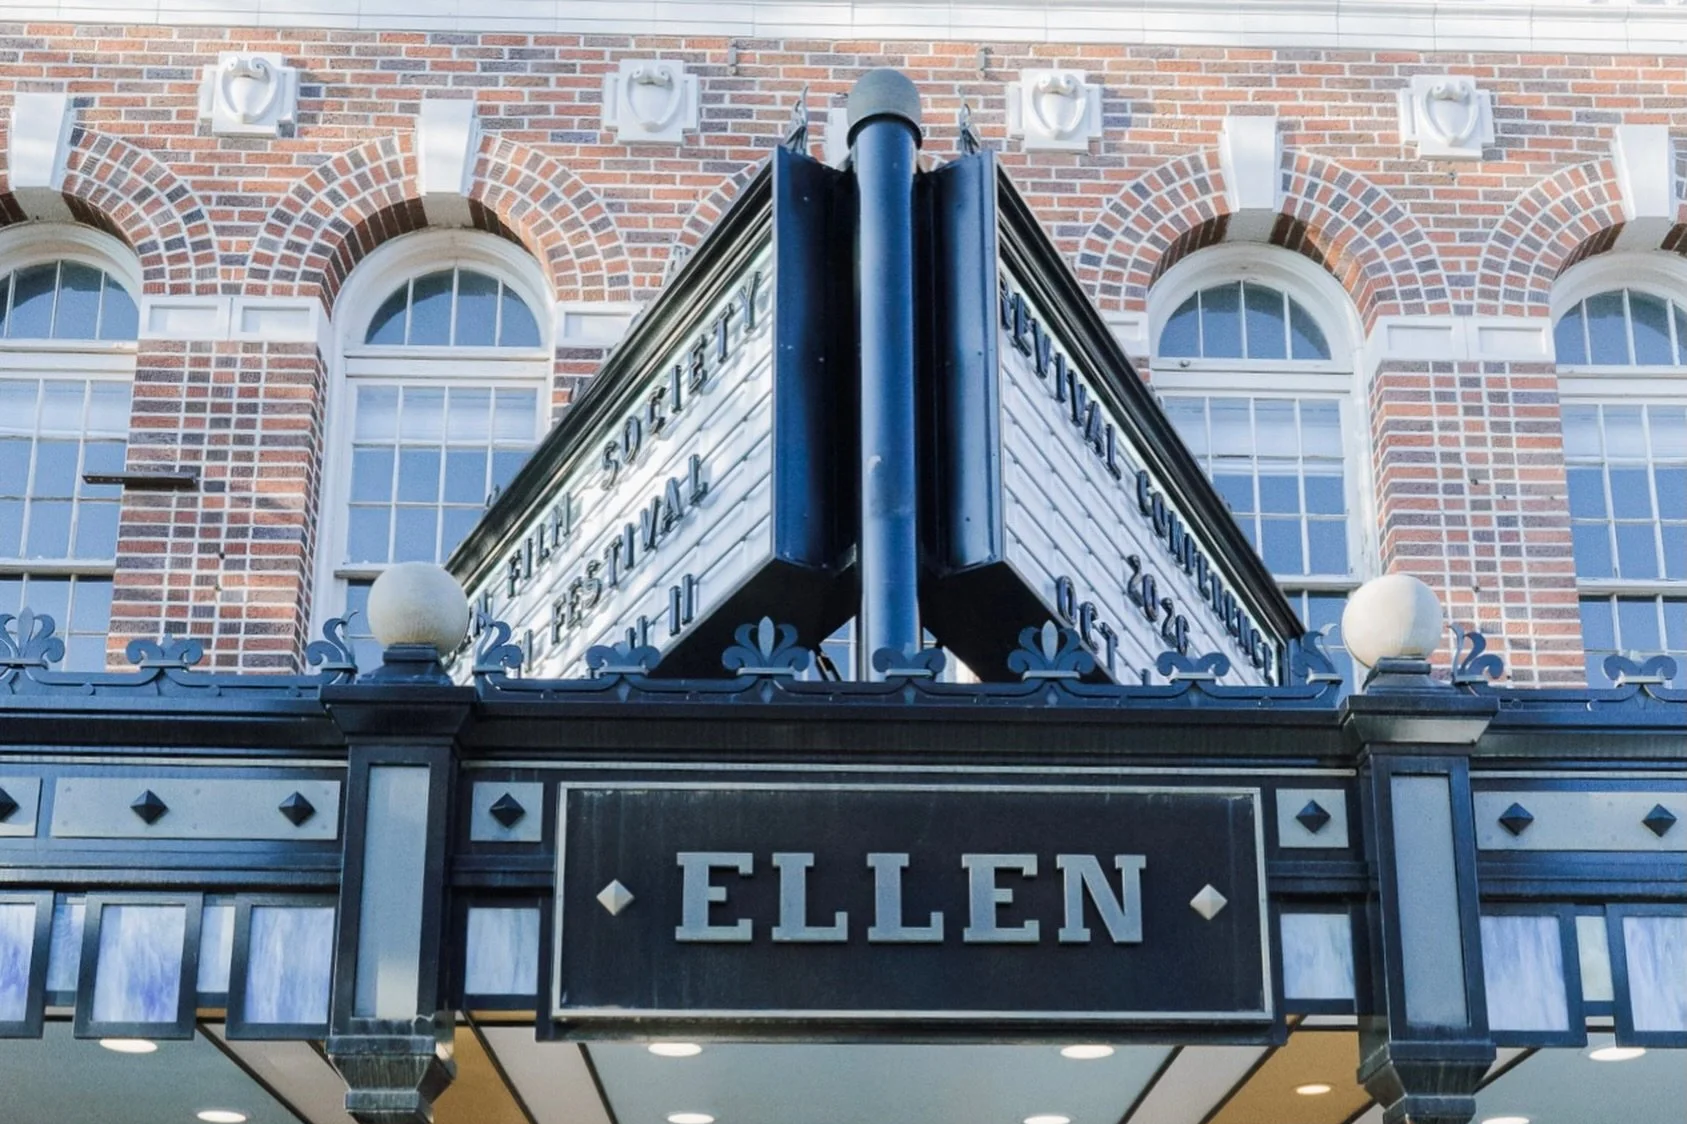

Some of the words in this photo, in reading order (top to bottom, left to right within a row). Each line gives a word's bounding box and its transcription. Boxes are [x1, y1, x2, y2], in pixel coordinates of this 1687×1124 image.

[507, 490, 573, 599] FILM
[600, 270, 762, 491] SOCIETY
[1000, 270, 1122, 481] REVIVAL
[551, 454, 709, 645] FESTIVAL
[1056, 575, 1119, 672] OCT
[675, 851, 1147, 944] ELLEN
